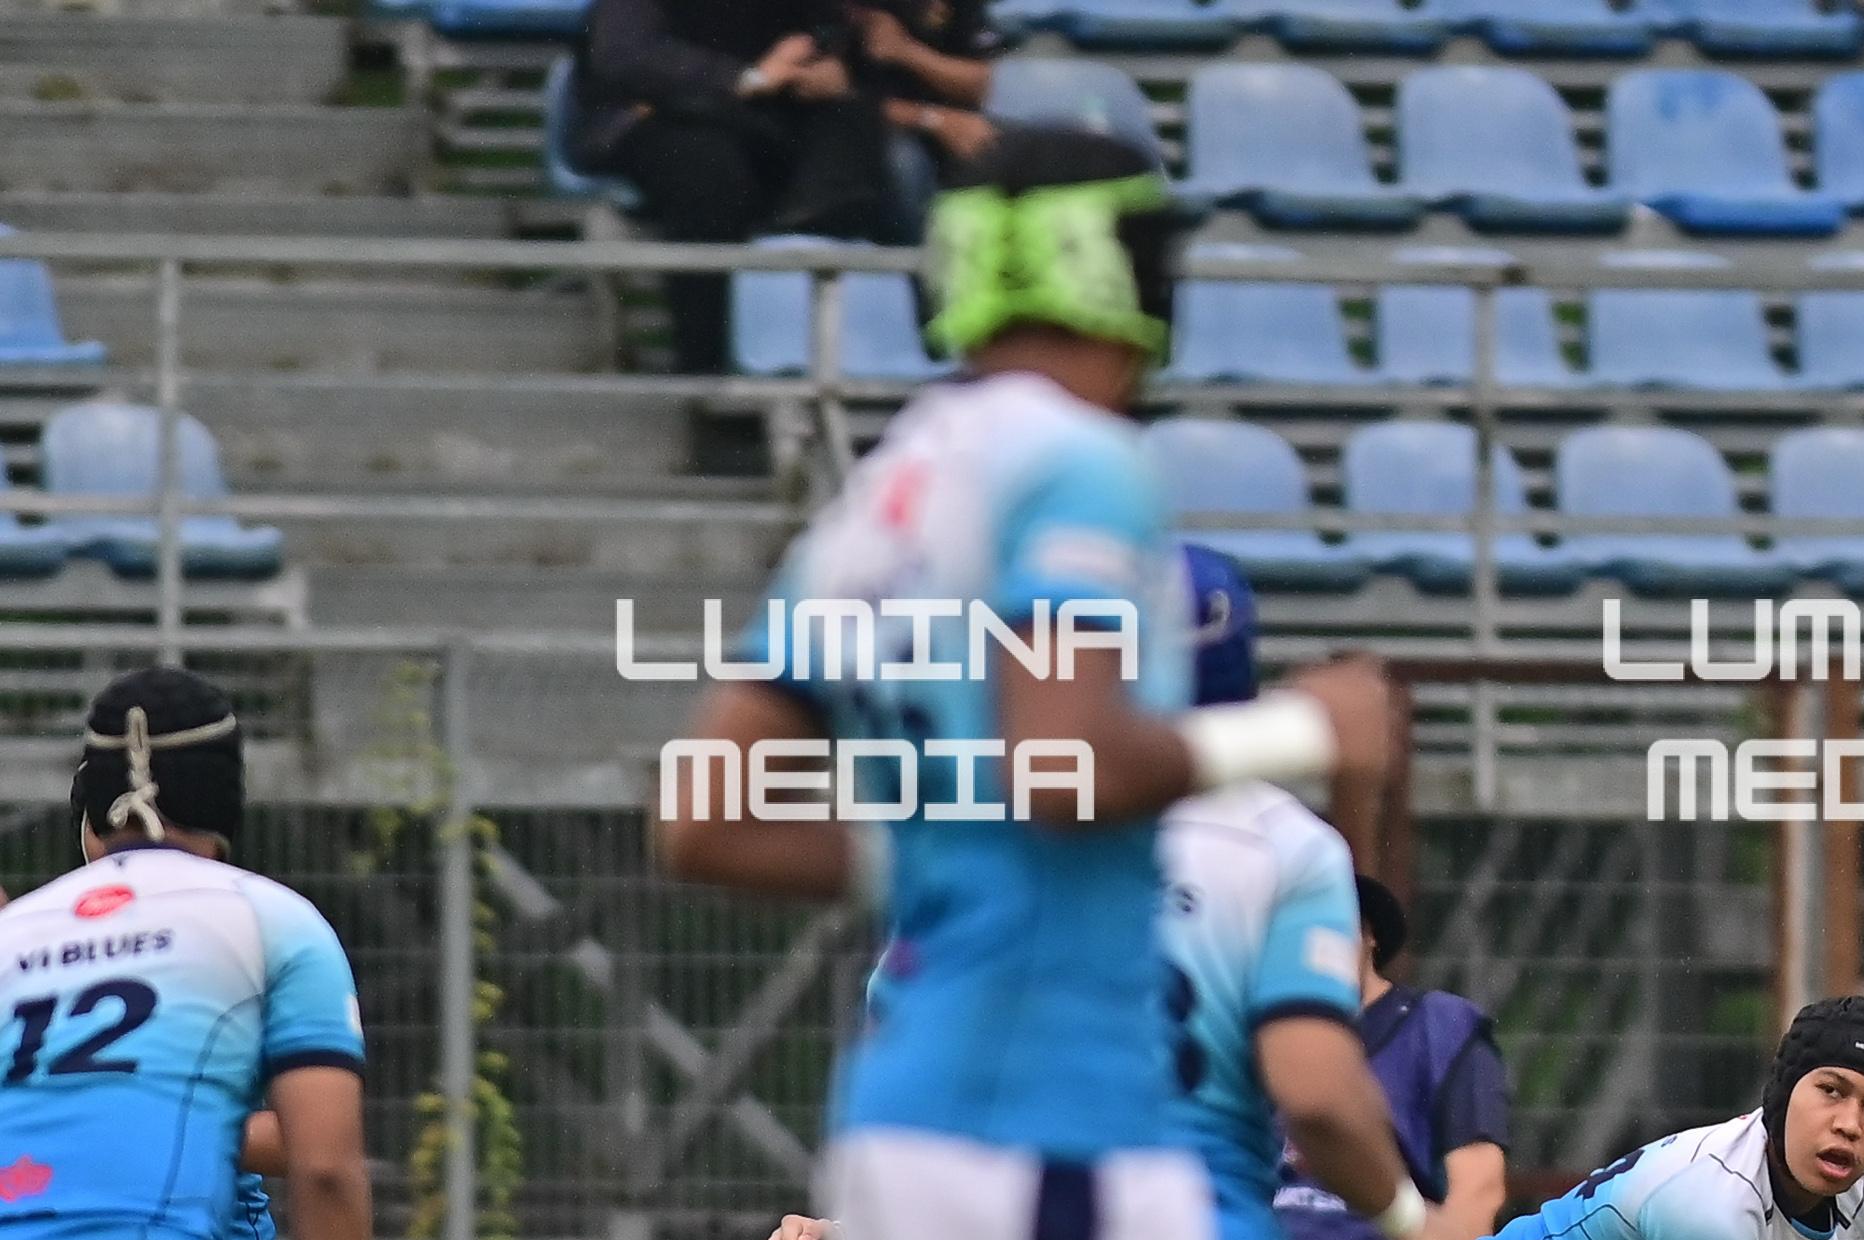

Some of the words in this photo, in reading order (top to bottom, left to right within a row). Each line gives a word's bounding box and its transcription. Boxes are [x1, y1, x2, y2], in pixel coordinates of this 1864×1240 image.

[17, 945, 51, 972] VI
[60, 929, 175, 964] BLUES
[3, 978, 158, 1086] 12
